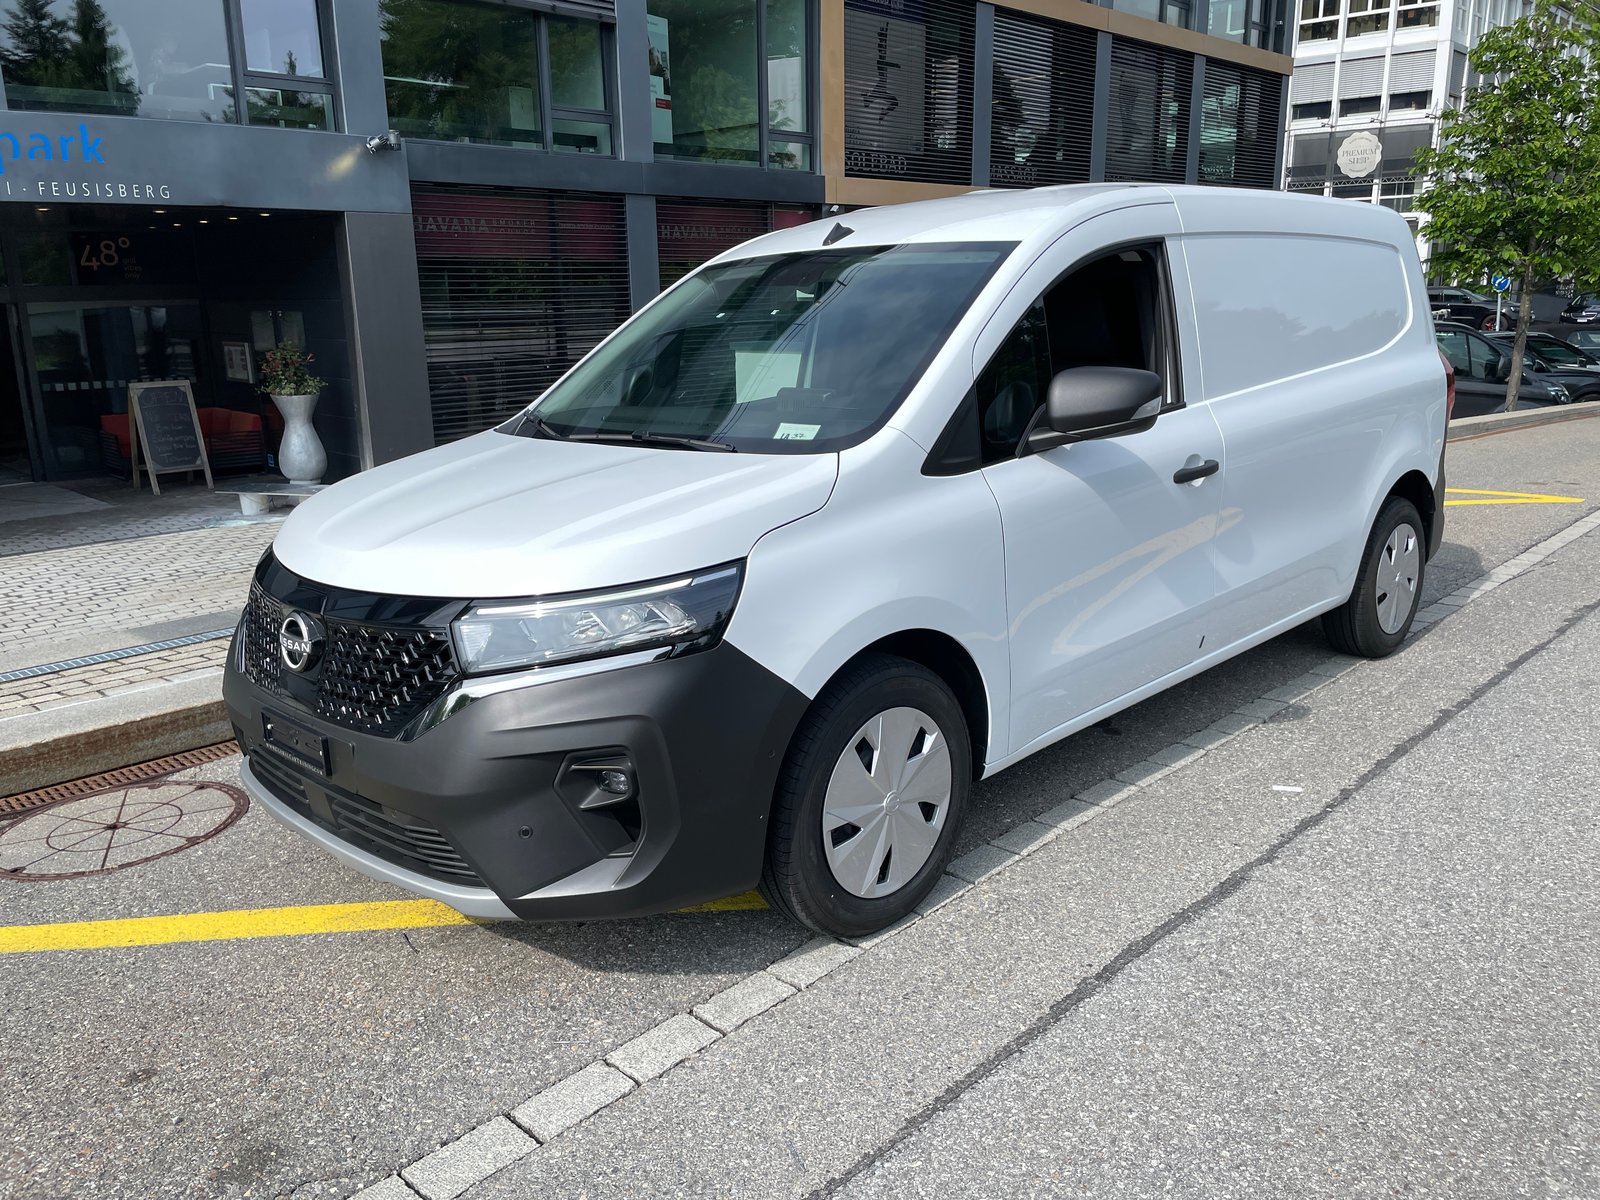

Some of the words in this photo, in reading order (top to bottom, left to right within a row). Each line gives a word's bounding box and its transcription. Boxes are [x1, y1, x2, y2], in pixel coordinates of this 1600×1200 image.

[1342, 148, 1377, 158] PREMIUM
[1347, 156, 1370, 165] SHOP
[38, 181, 171, 199] FEUSISBERG
